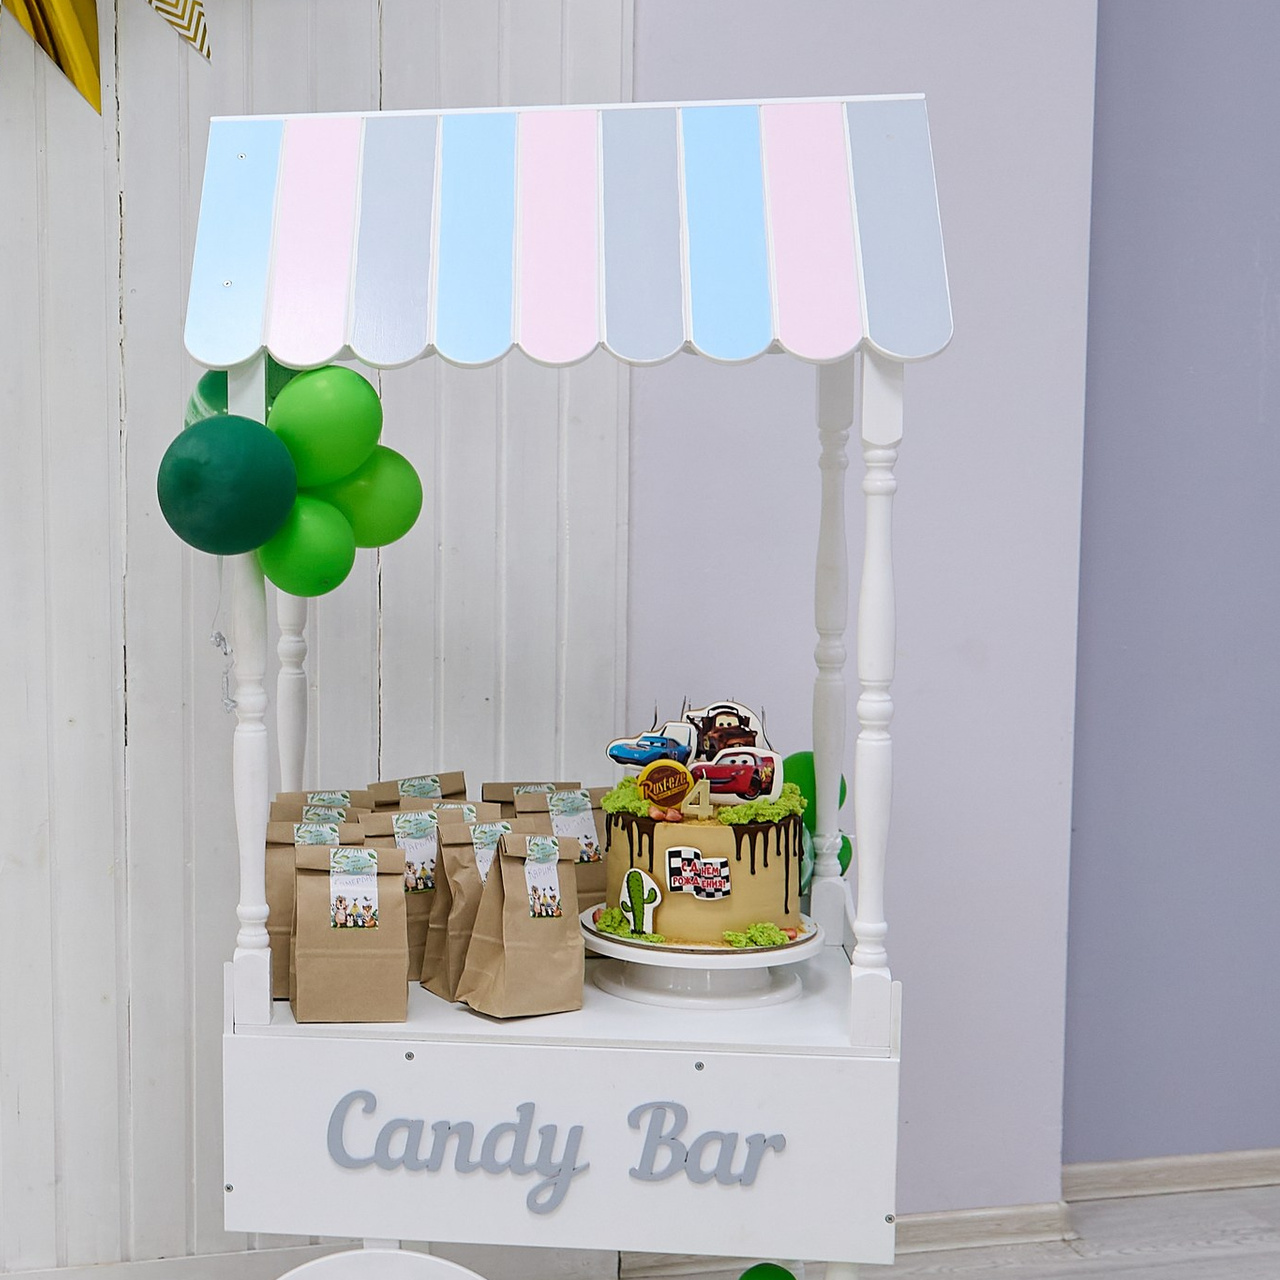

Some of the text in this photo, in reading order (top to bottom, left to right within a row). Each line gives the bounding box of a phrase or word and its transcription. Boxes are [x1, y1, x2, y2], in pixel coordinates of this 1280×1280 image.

[681, 780, 713, 820] 4
[672, 876, 726, 889] РОЖДЕНИЯ!
[326, 1089, 787, 1215] Candy Bar
